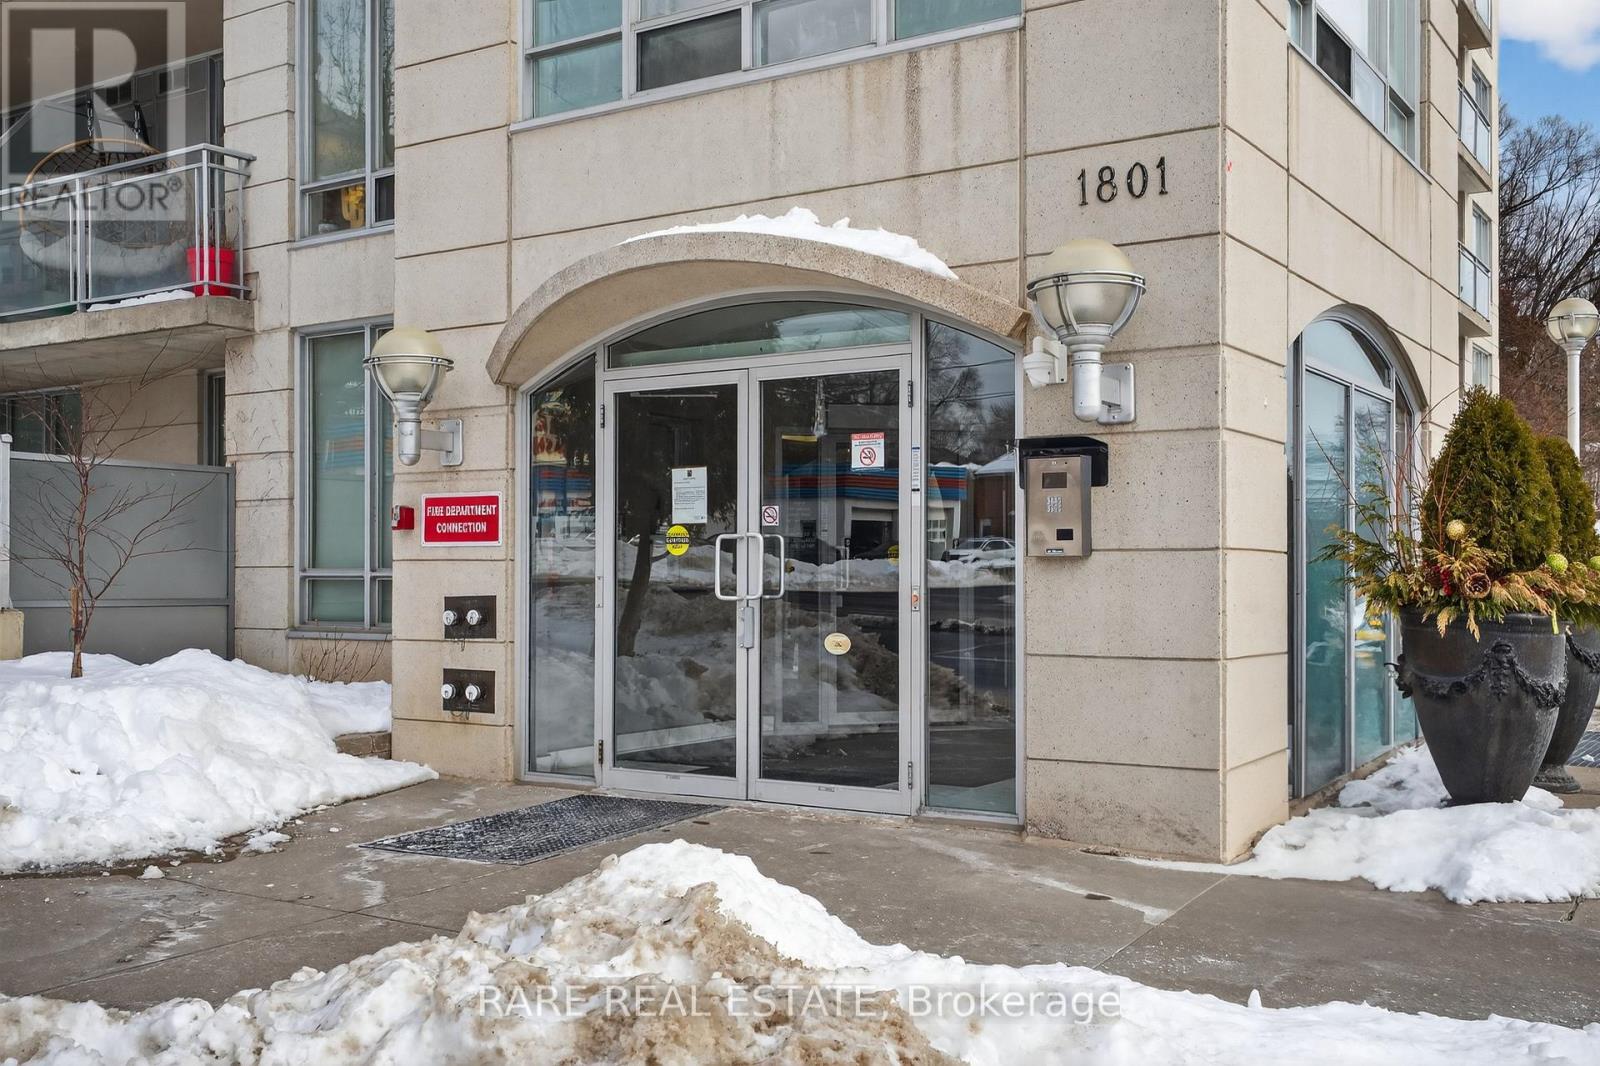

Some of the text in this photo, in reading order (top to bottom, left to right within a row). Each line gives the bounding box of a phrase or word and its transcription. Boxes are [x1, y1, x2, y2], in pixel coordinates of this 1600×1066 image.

[1077, 156, 1168, 206] 1801
[427, 505, 497, 517] FIRE DEPARTMENT
[436, 522, 487, 533] CONNECTION
